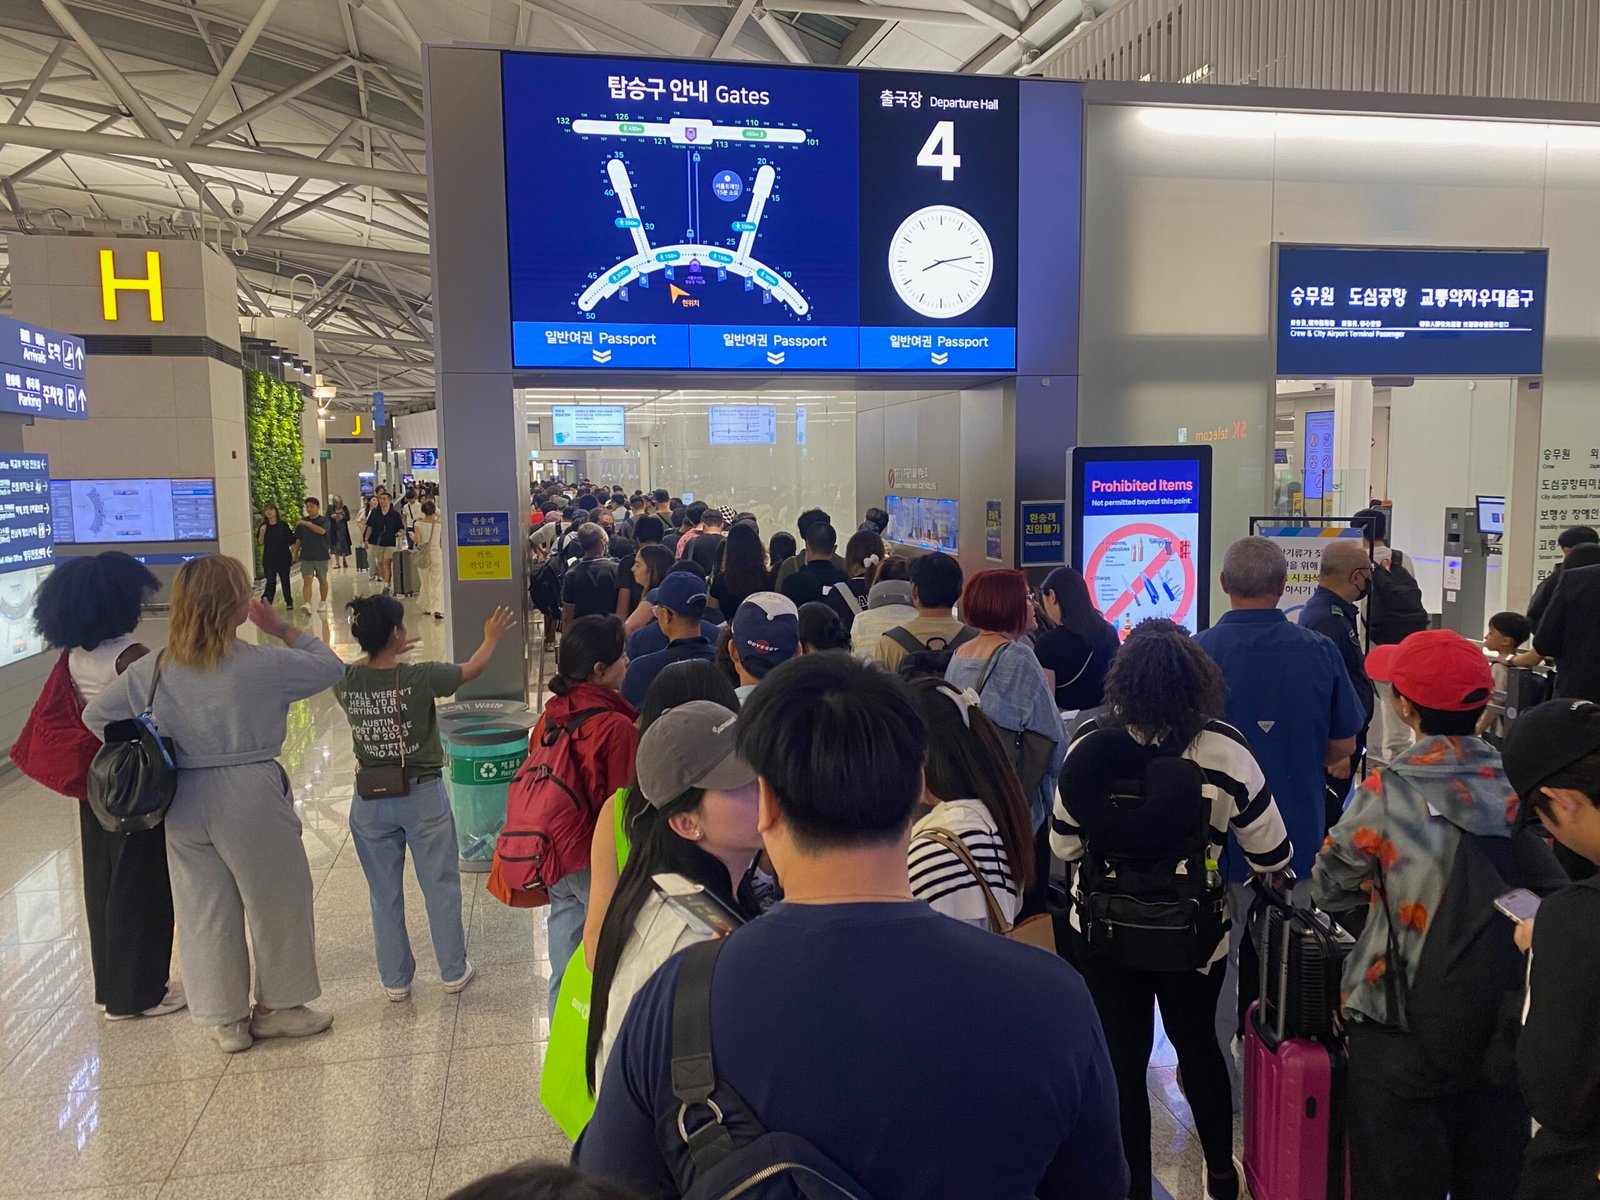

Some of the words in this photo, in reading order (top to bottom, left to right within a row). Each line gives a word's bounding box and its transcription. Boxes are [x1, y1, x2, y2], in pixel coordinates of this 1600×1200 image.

[608, 76, 666, 100] 탑승구
[670, 78, 708, 103] 안내
[716, 86, 770, 105] Gates
[880, 89, 922, 108] 출국장
[930, 96, 979, 110] Departure
[980, 99, 998, 110] Hall
[917, 120, 960, 181] 4
[100, 249, 164, 322] H
[1290, 286, 1334, 306] 승무원
[1348, 288, 1408, 307] 도심공항
[1420, 288, 1534, 308] 교통약자우대출구
[545, 331, 593, 344] 일반여권
[599, 332, 656, 347] Passport
[722, 333, 768, 347] 일반여권
[773, 335, 827, 349] Passport
[1314, 330, 1326, 338] City
[1376, 331, 1405, 339] Passenger
[890, 335, 932, 348] 일반여권
[938, 336, 988, 349] Passport
[23, 347, 46, 364] Arrivals
[18, 392, 42, 412] Parking
[43, 385, 63, 406] 주차장
[352, 415, 361, 436] J
[1544, 449, 1570, 460] 승무원
[1092, 479, 1156, 492] Prohibited
[1160, 479, 1193, 491] Items
[1104, 499, 1136, 507] permitted
[1030, 513, 1056, 523] 환승객
[1541, 509, 1567, 520] 보행상
[1572, 509, 1599, 520] 장애인
[1025, 524, 1060, 534] 진입불가
[1283, 549, 1312, 557] 기류가
[1287, 561, 1298, 570] 을
[1301, 561, 1318, 570] 위해
[1292, 574, 1300, 582] 시
[350, 700, 373, 708] HERE,
[362, 718, 394, 728] AUSTIN
